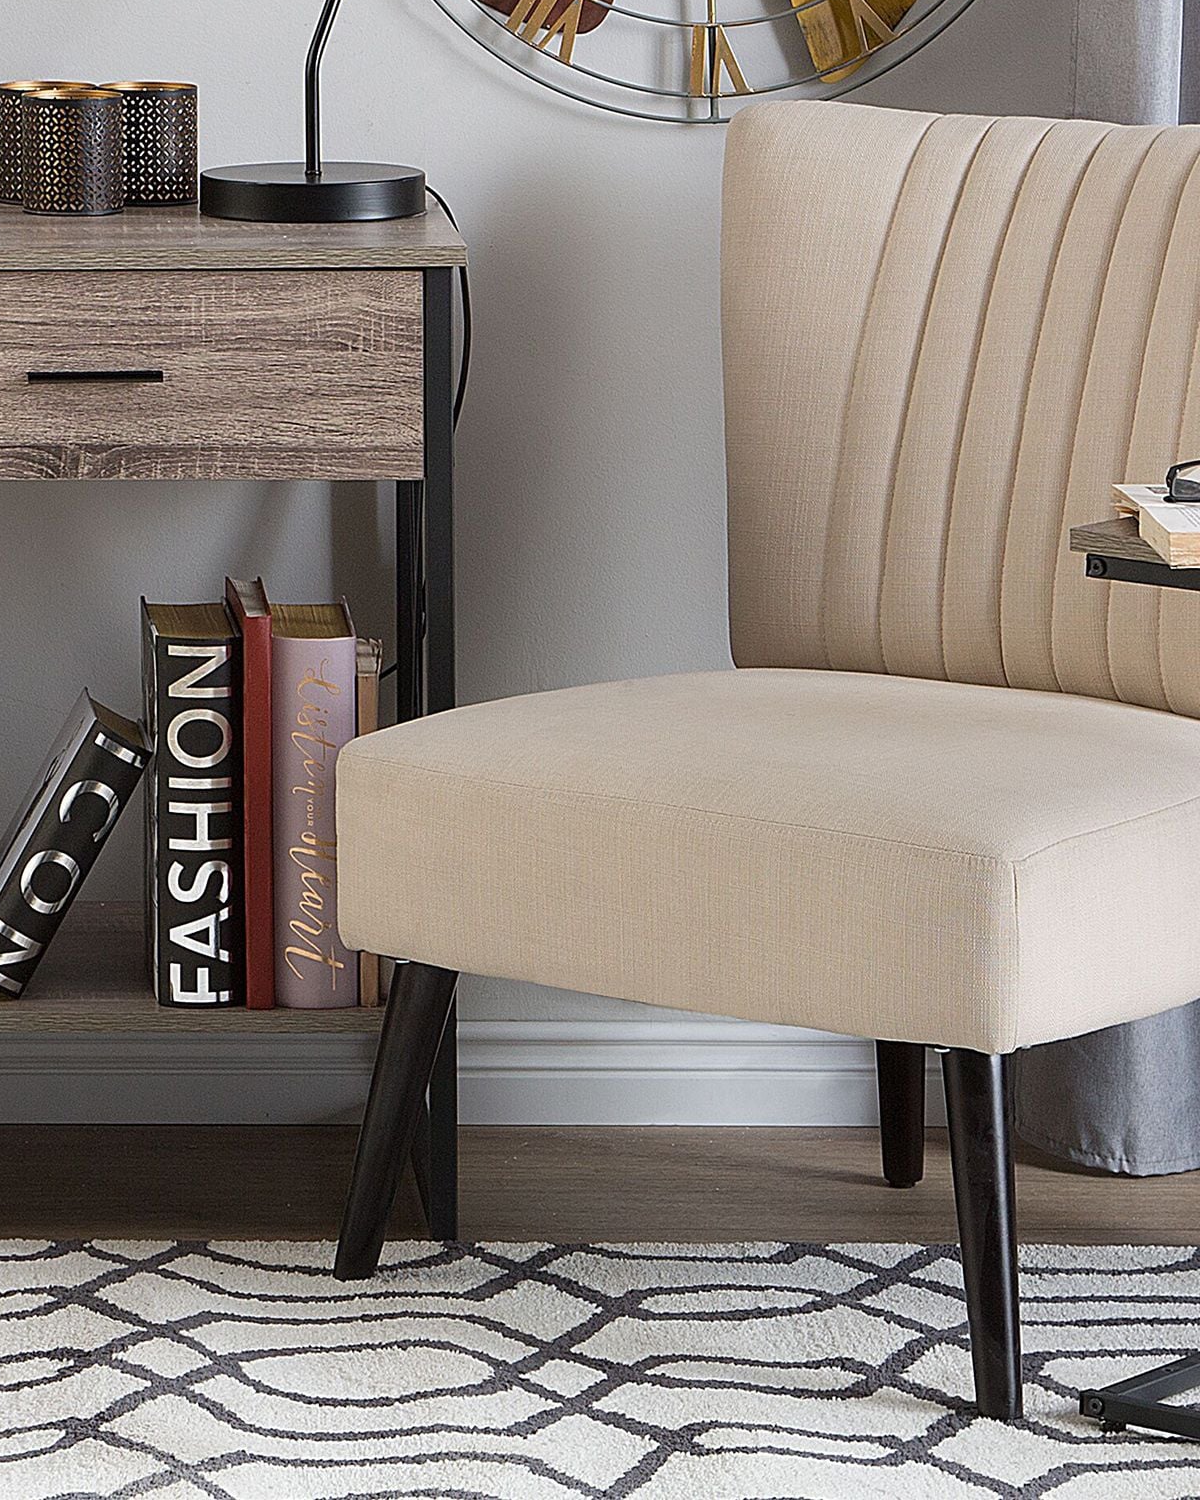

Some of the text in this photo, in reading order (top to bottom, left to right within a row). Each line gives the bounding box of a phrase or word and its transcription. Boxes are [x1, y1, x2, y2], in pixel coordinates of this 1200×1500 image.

[291, 658, 341, 798] Listen
[166, 643, 233, 1004] FASHION
[307, 799, 315, 828] YOUR
